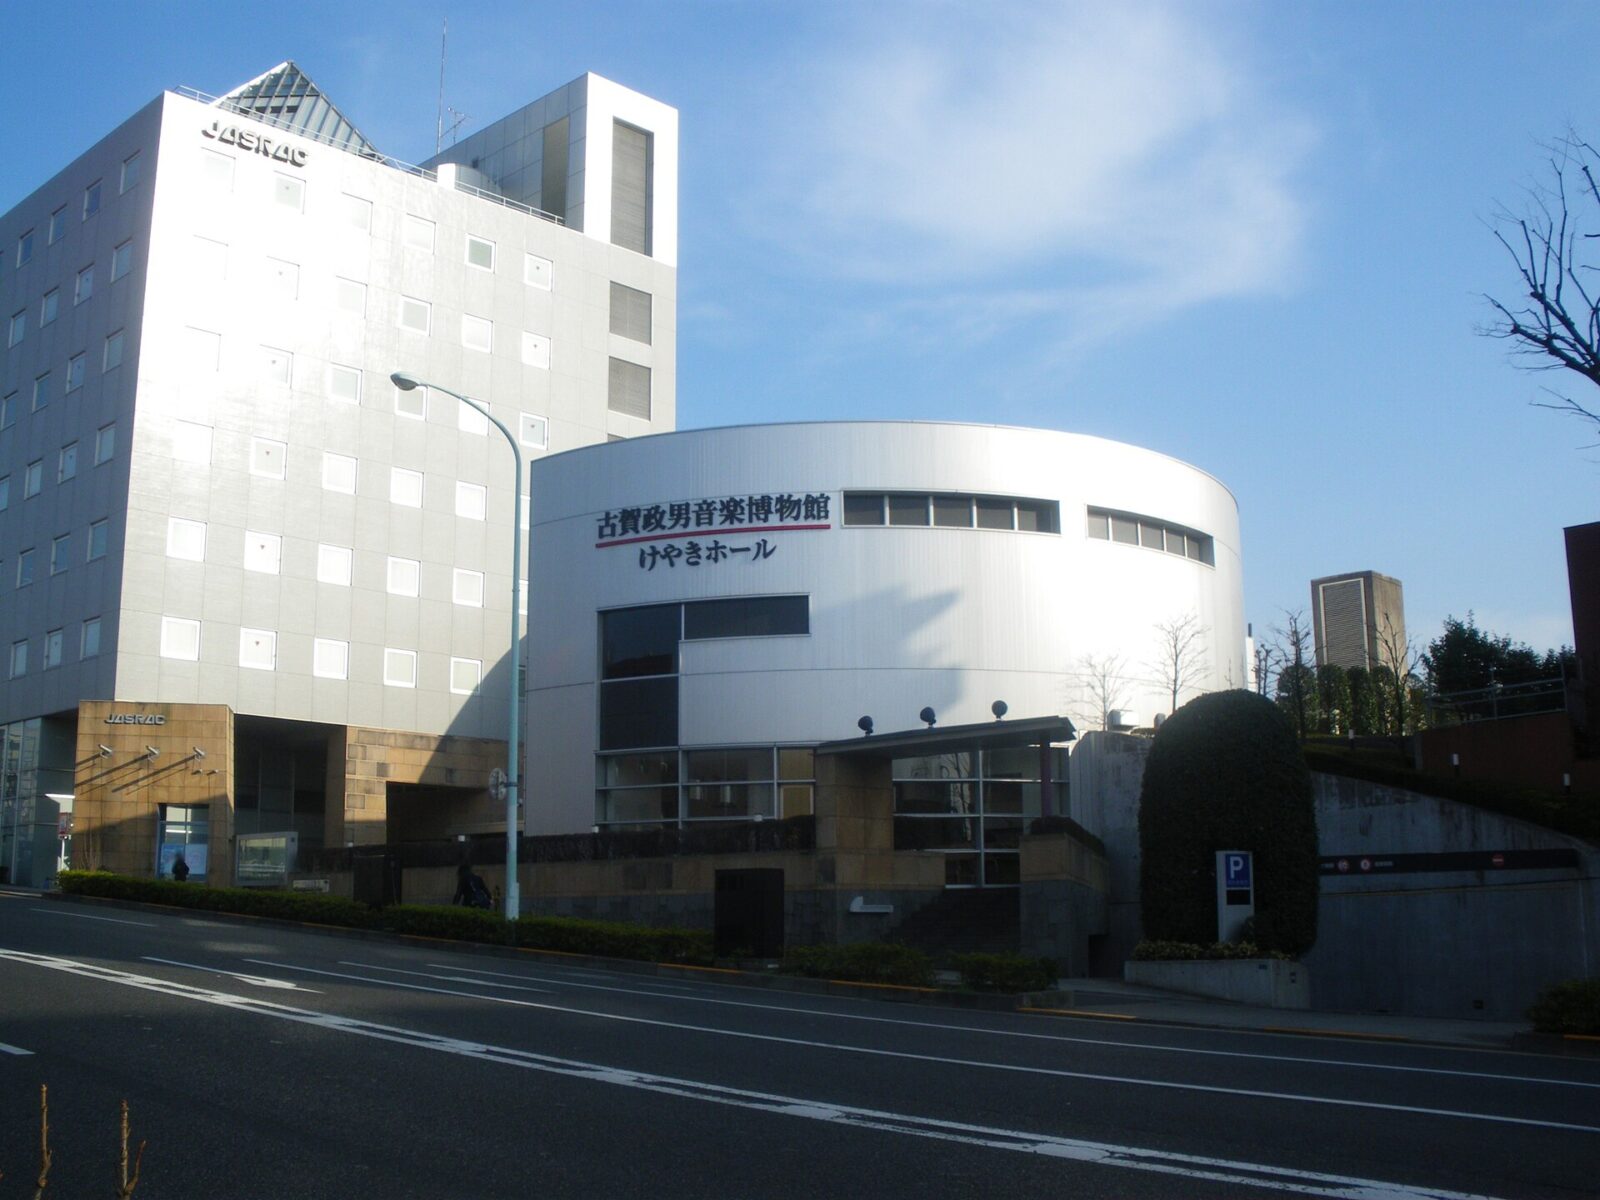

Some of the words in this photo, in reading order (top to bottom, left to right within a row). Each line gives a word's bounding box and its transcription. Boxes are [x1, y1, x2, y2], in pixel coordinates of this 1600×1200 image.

[201, 120, 309, 168] JASRAC
[596, 493, 831, 540] 古賀政男音楽博物館
[639, 539, 777, 572] けやきホール
[104, 713, 166, 726] JASRAC
[1229, 856, 1244, 880] P
